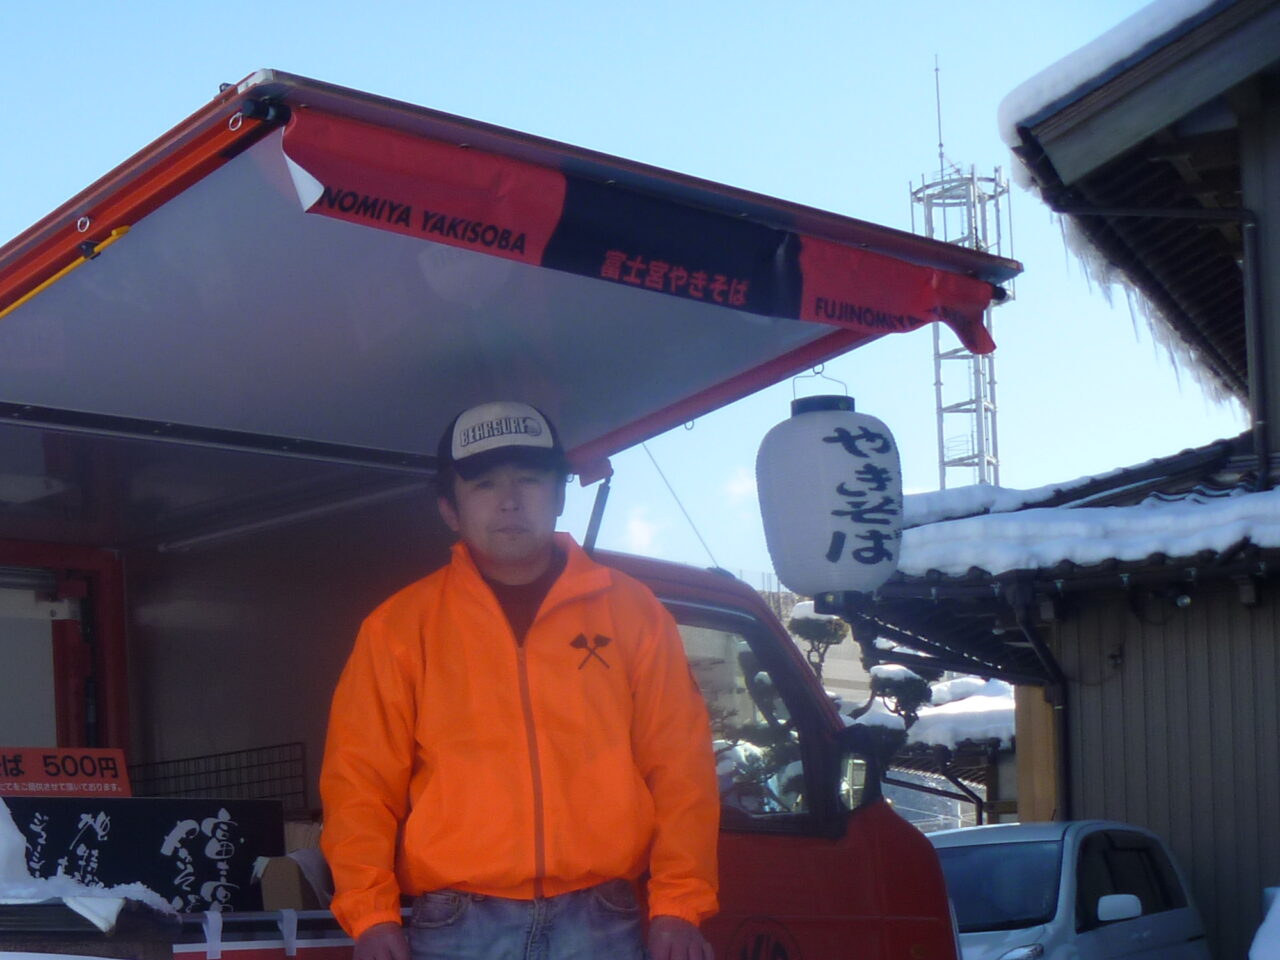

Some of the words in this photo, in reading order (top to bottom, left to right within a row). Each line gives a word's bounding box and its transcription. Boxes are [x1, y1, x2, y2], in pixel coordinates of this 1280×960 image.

[423, 210, 527, 254] YAKISOBA
[600, 250, 749, 306] 富士宮やきそば
[822, 425, 902, 565] やきそば
[42, 754, 119, 779] 500円
